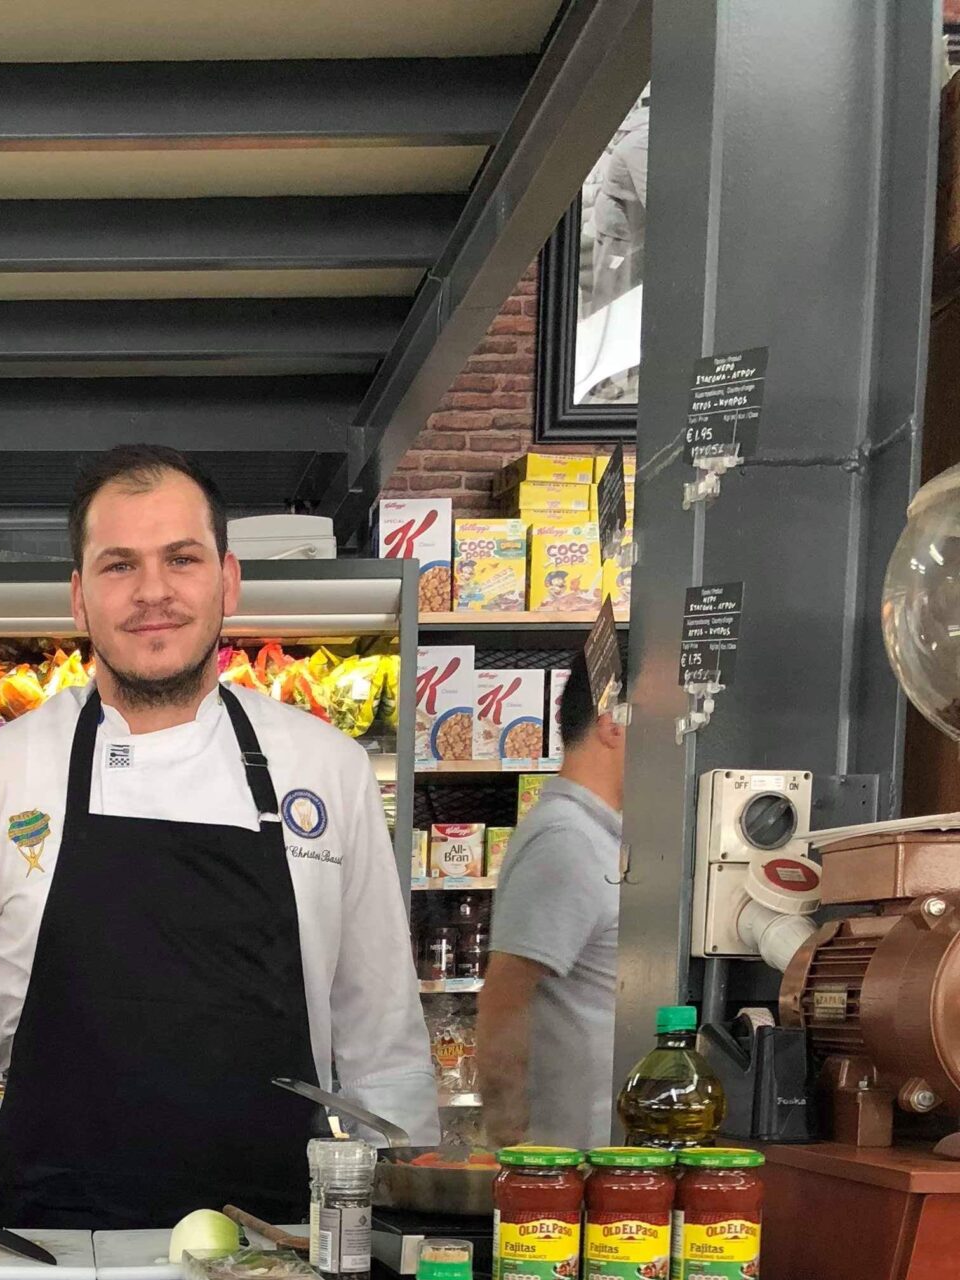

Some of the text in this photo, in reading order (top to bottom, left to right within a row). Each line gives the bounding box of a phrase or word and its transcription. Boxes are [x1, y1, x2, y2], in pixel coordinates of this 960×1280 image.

[384, 509, 439, 559] K
[465, 549, 492, 560] pops
[555, 554, 585, 567] pops
[416, 657, 461, 716] K
[477, 677, 522, 725] K
[734, 782, 749, 790] OFF
[789, 783, 799, 791] ON
[444, 852, 469, 862] Bran
[504, 1241, 536, 1253] Fajitas
[590, 1242, 619, 1254] Fajitas
[690, 1243, 724, 1254] Fajitas
